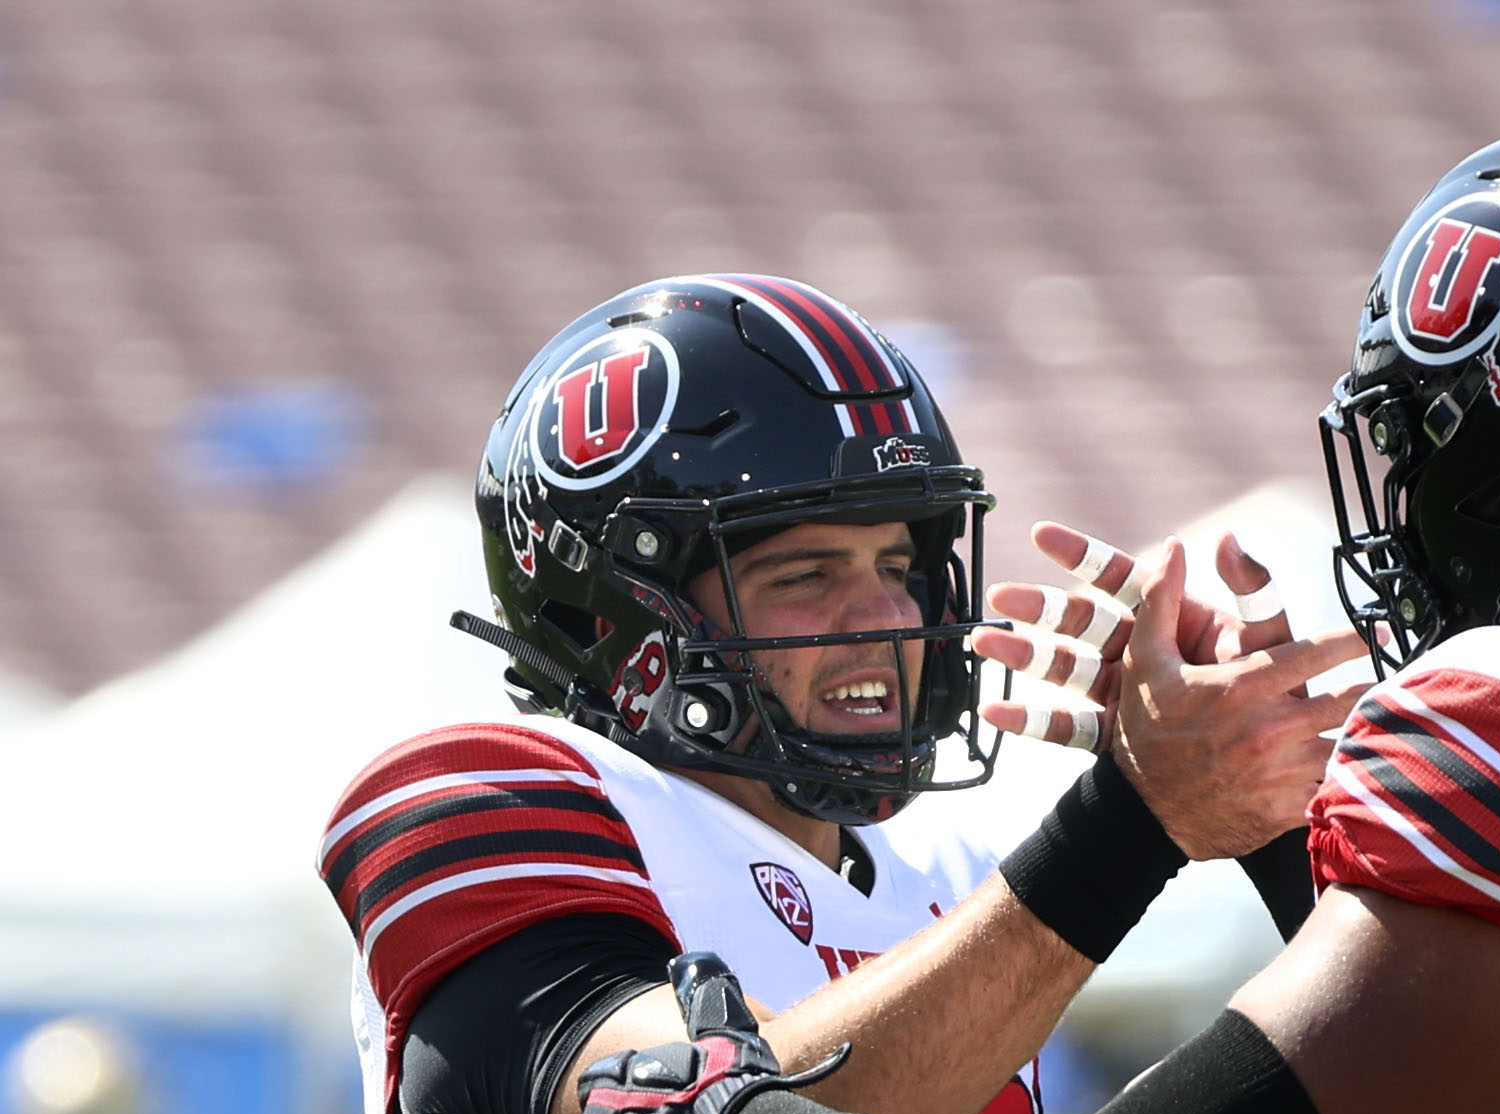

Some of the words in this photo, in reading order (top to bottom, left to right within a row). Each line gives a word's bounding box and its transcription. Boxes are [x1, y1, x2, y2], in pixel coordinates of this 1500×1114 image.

[553, 346, 649, 470] U
[754, 865, 809, 914] PAC
[778, 898, 809, 926] 12
